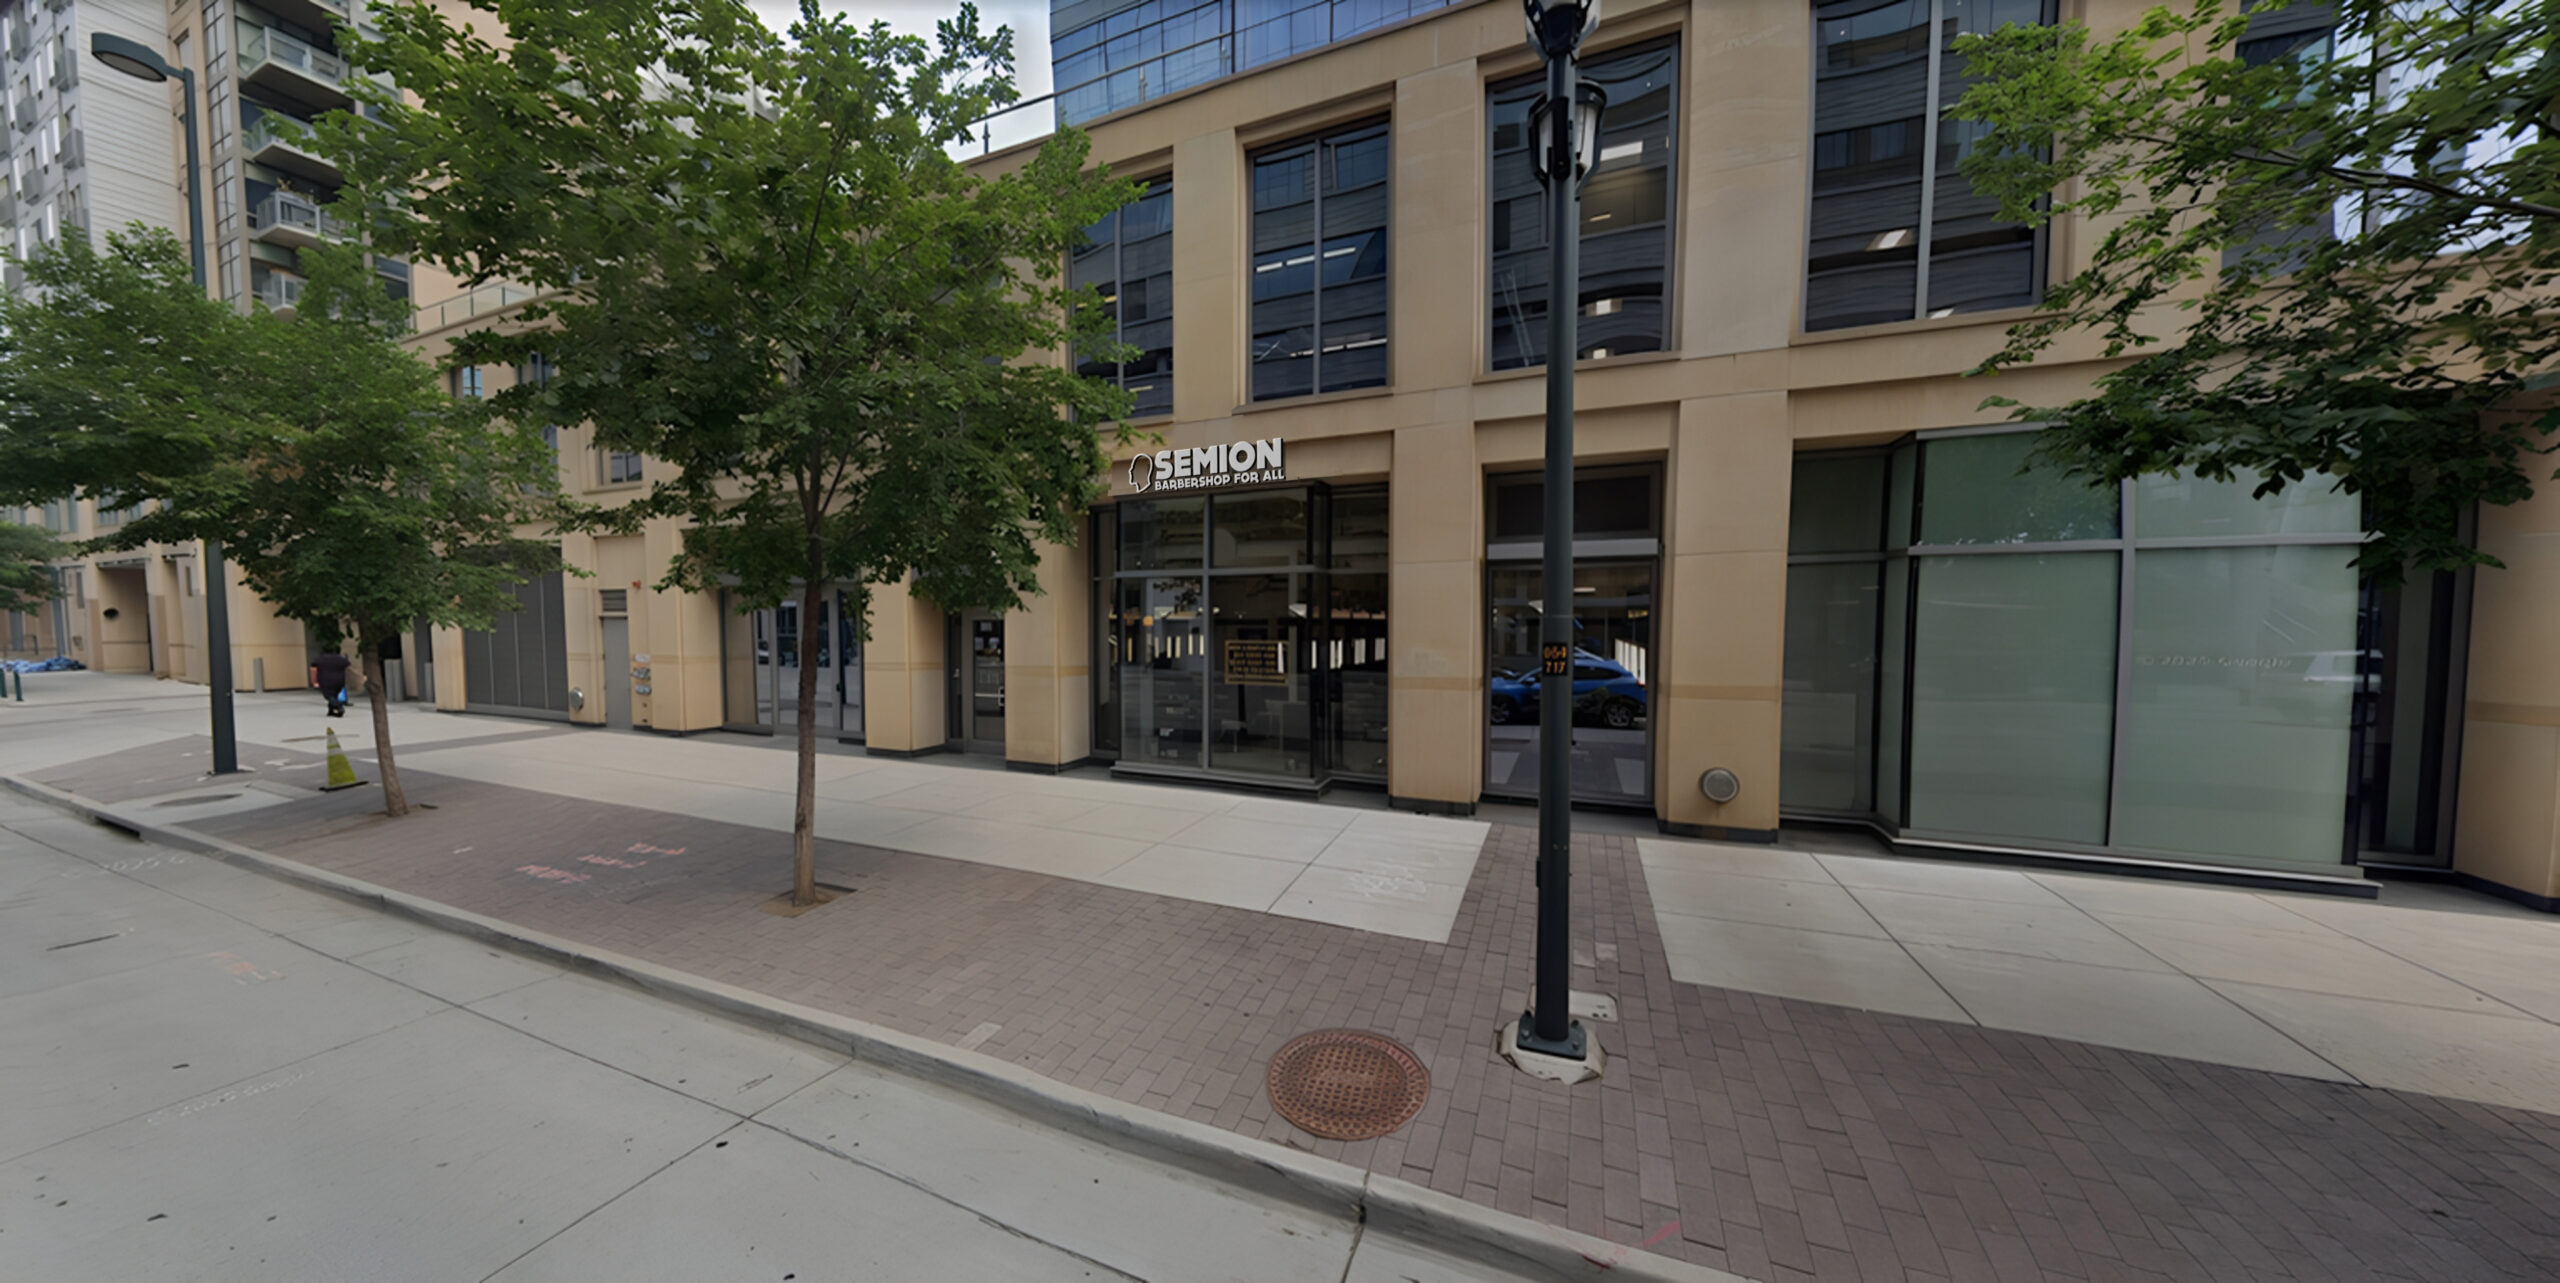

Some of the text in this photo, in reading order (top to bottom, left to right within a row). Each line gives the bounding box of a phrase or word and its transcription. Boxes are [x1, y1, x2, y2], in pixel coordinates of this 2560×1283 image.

[1154, 437, 1284, 480] SEMION
[1154, 469, 1285, 491] BARBERSHOP FOR ALL
